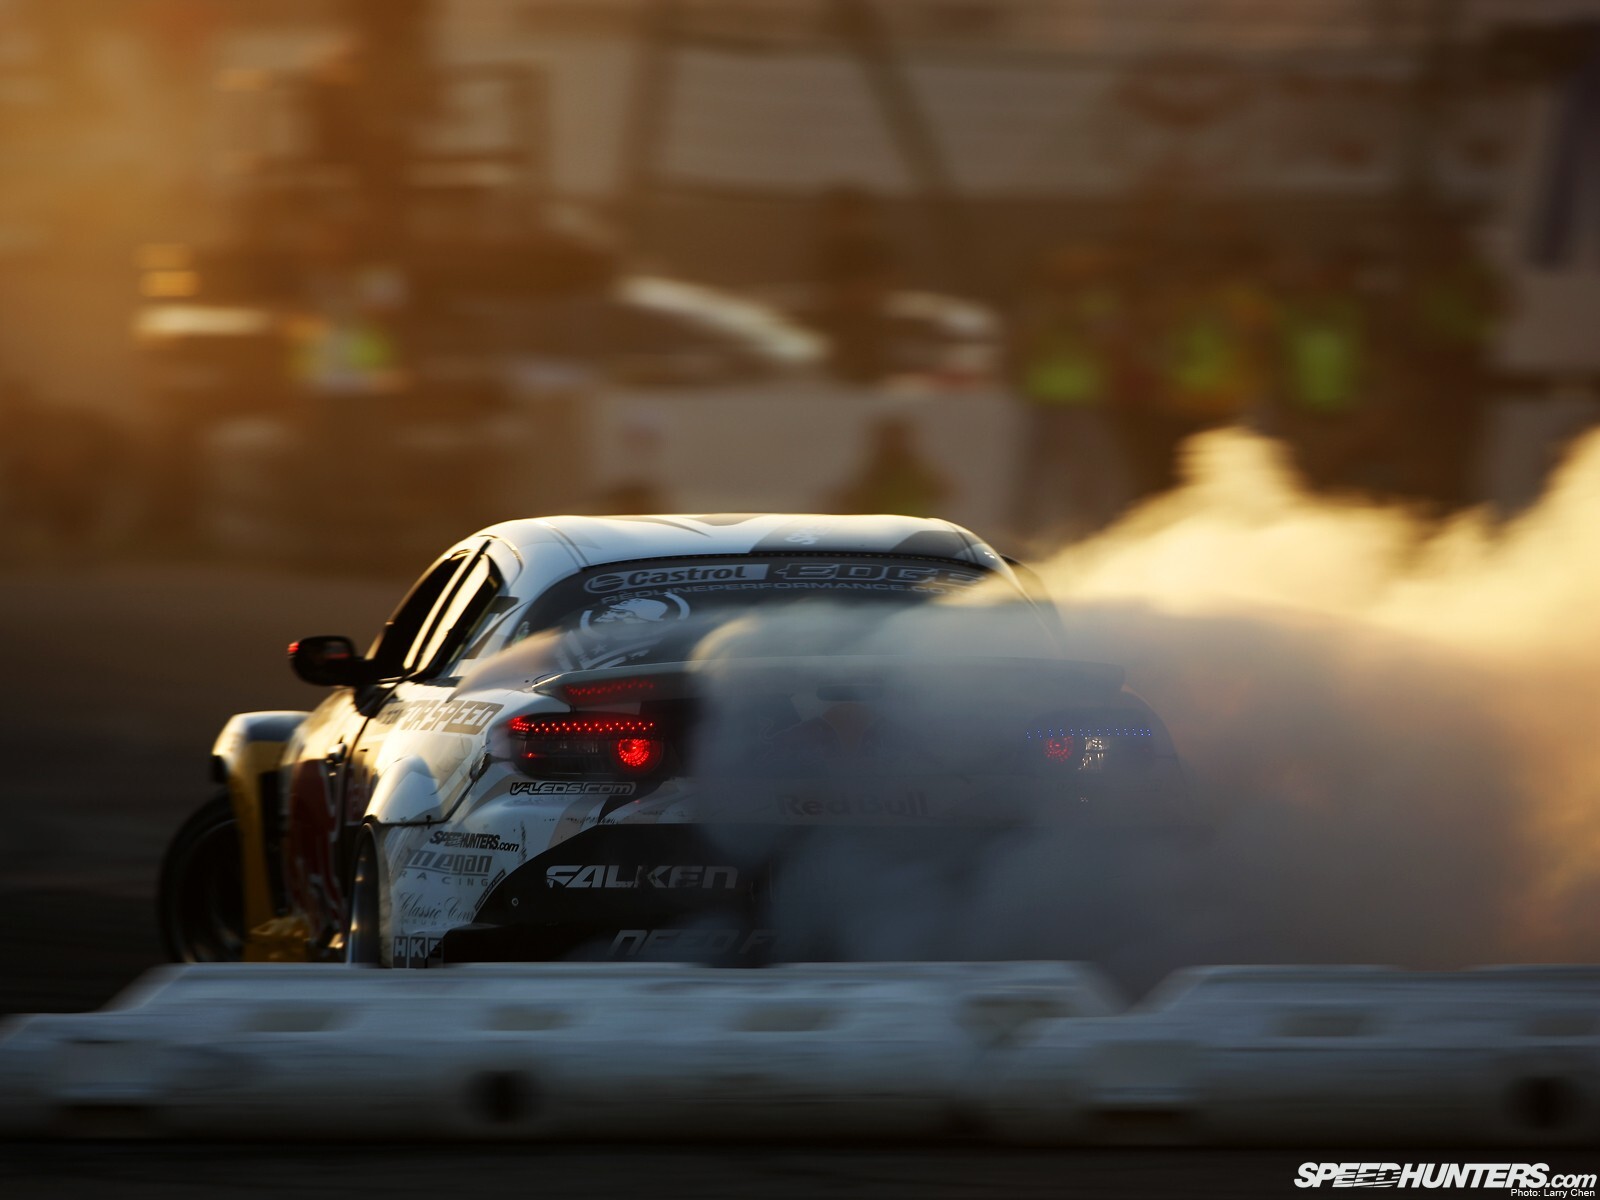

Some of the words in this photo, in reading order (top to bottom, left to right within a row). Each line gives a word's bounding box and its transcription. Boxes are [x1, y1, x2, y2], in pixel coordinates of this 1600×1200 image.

[628, 566, 748, 586] Castrol
[775, 562, 986, 587] EDGE
[599, 581, 952, 606] REDLINEPERFORMANCE.CO
[777, 793, 850, 816] Red
[857, 790, 929, 817] Bull
[430, 831, 519, 853] SPEEDHUNTERS.com
[404, 849, 493, 874] megan
[398, 871, 489, 887] RACING
[546, 864, 738, 889] FALKEN
[399, 891, 442, 919] Classic
[609, 929, 739, 956] NEED
